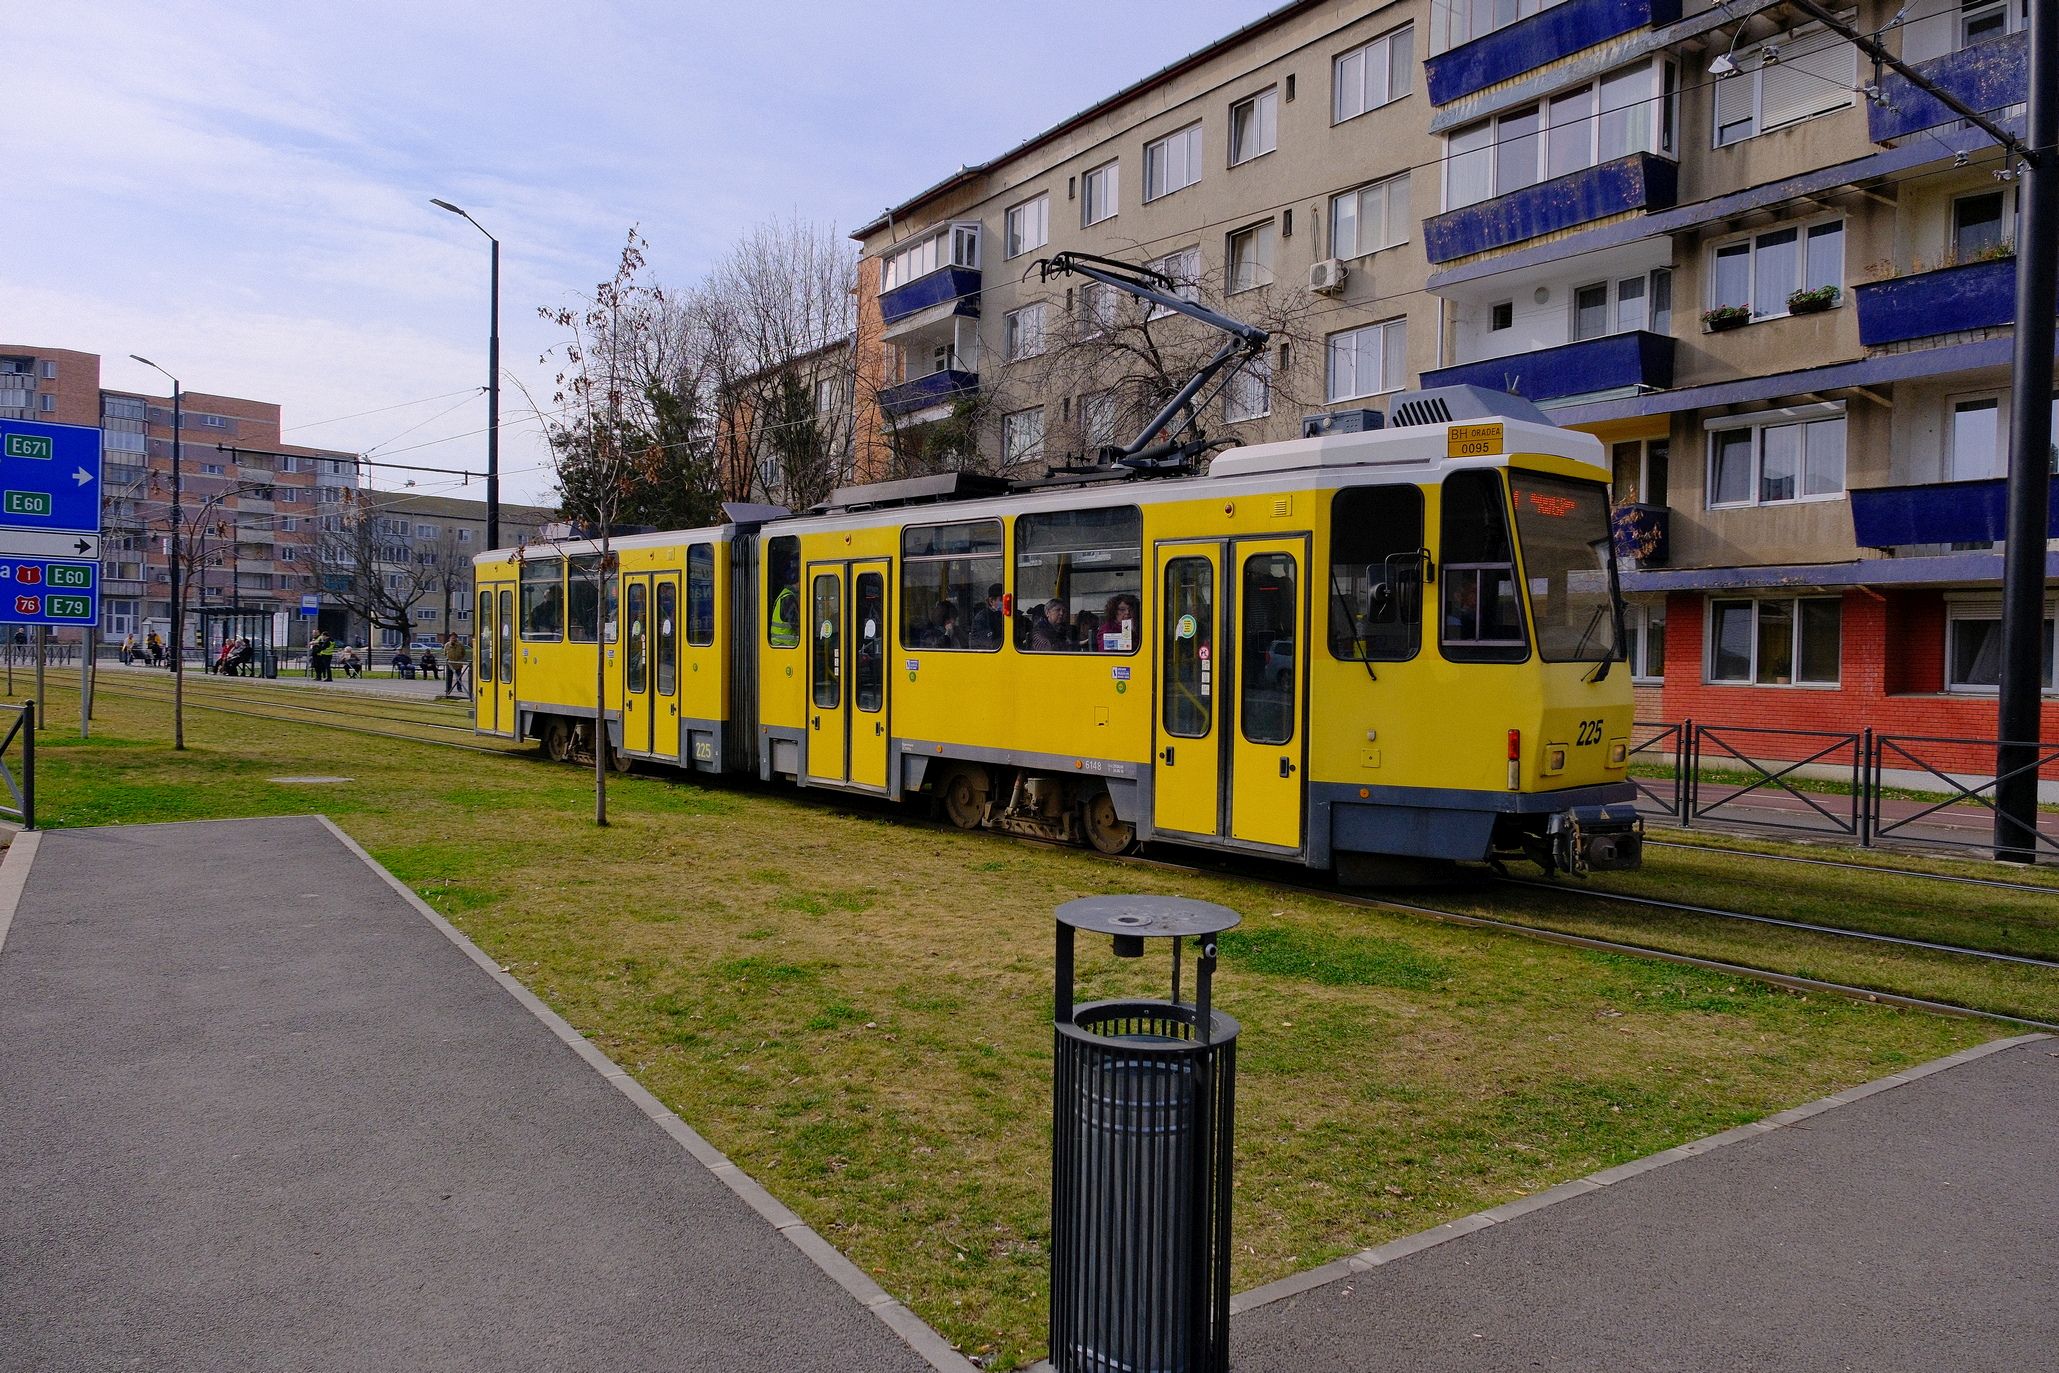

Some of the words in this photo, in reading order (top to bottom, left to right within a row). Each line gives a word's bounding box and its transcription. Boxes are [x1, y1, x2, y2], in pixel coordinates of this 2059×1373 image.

[1451, 429, 1468, 440] BH
[1471, 427, 1501, 437] ORADEA
[12, 438, 47, 455] E671
[1461, 442, 1489, 454] 0095
[12, 494, 43, 511] E60
[27, 570, 31, 581] 1
[54, 568, 84, 584] E60
[21, 600, 35, 611] 76
[53, 598, 83, 614] E79
[1576, 719, 1604, 746] 225
[696, 742, 712, 758] 225
[1085, 760, 1102, 771] 6148
